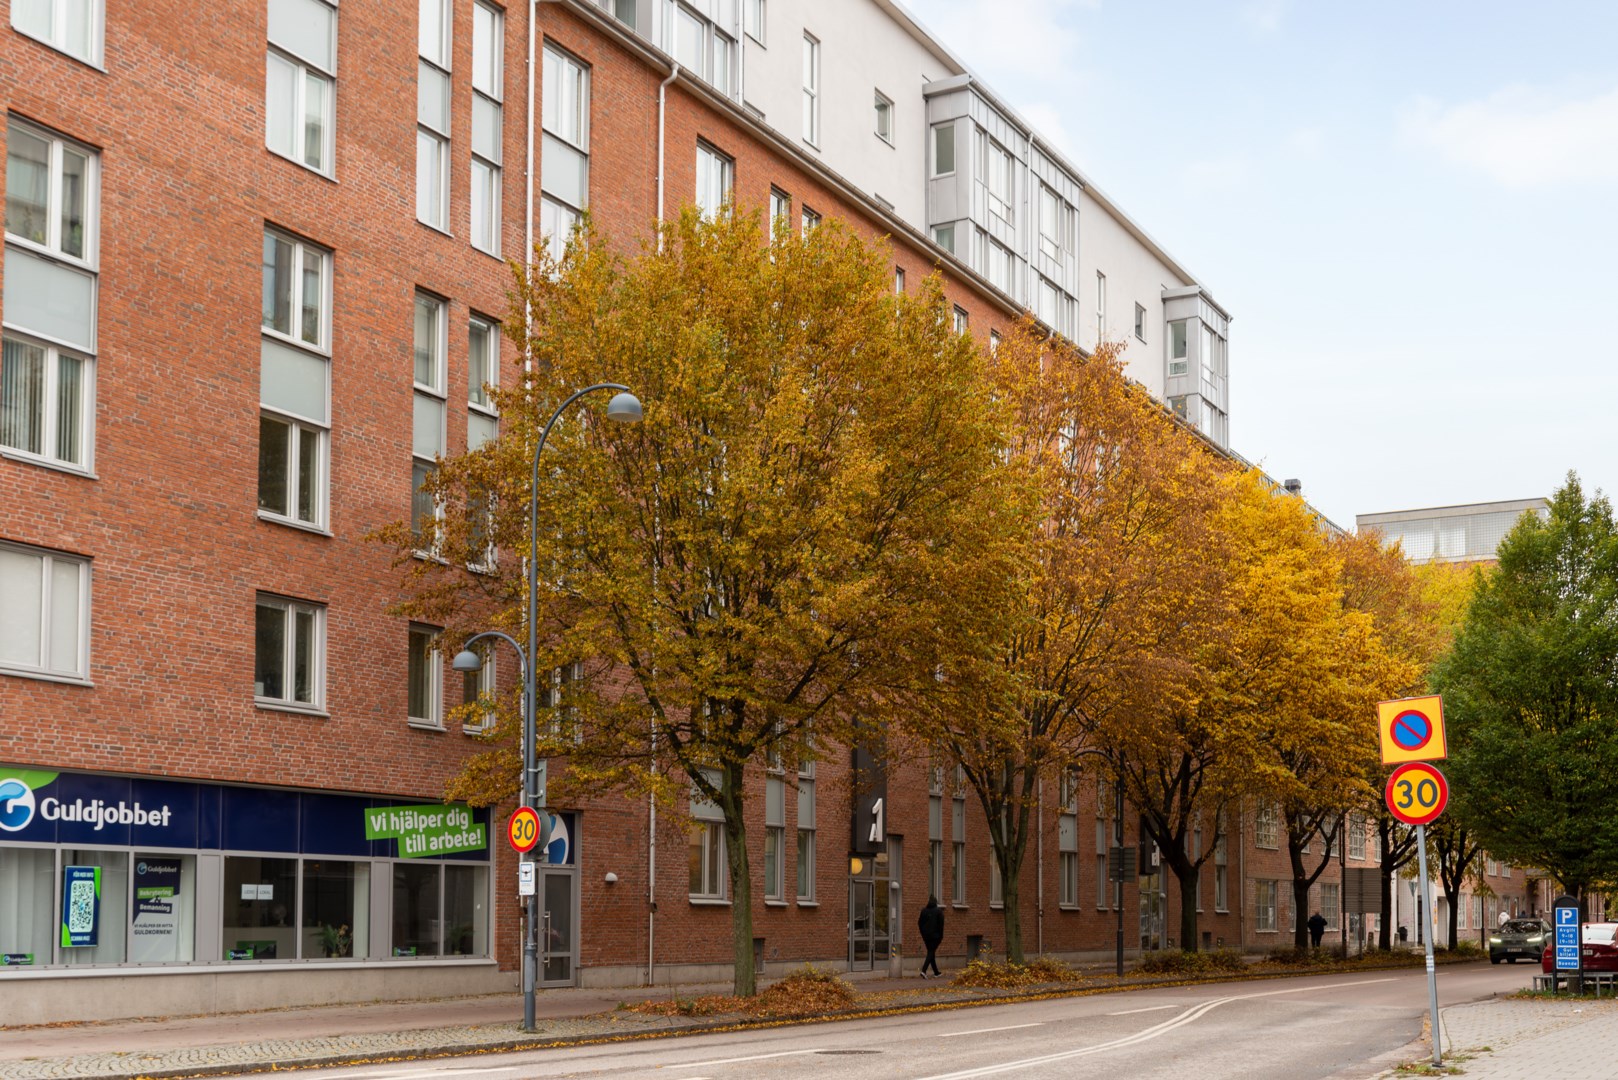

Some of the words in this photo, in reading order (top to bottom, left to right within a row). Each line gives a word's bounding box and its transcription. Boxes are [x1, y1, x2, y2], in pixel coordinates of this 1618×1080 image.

[1396, 778, 1438, 809] 30
[40, 797, 171, 831] Guldjobbet
[370, 812, 387, 832] Vi
[390, 810, 444, 834] hjälper
[446, 808, 468, 830] dig
[405, 834, 427, 853] till
[429, 828, 482, 851] arbete!
[513, 818, 535, 841] 30
[147, 866, 177, 874] Guldjobbet
[139, 903, 171, 912] Bemanning
[1562, 910, 1572, 923] P
